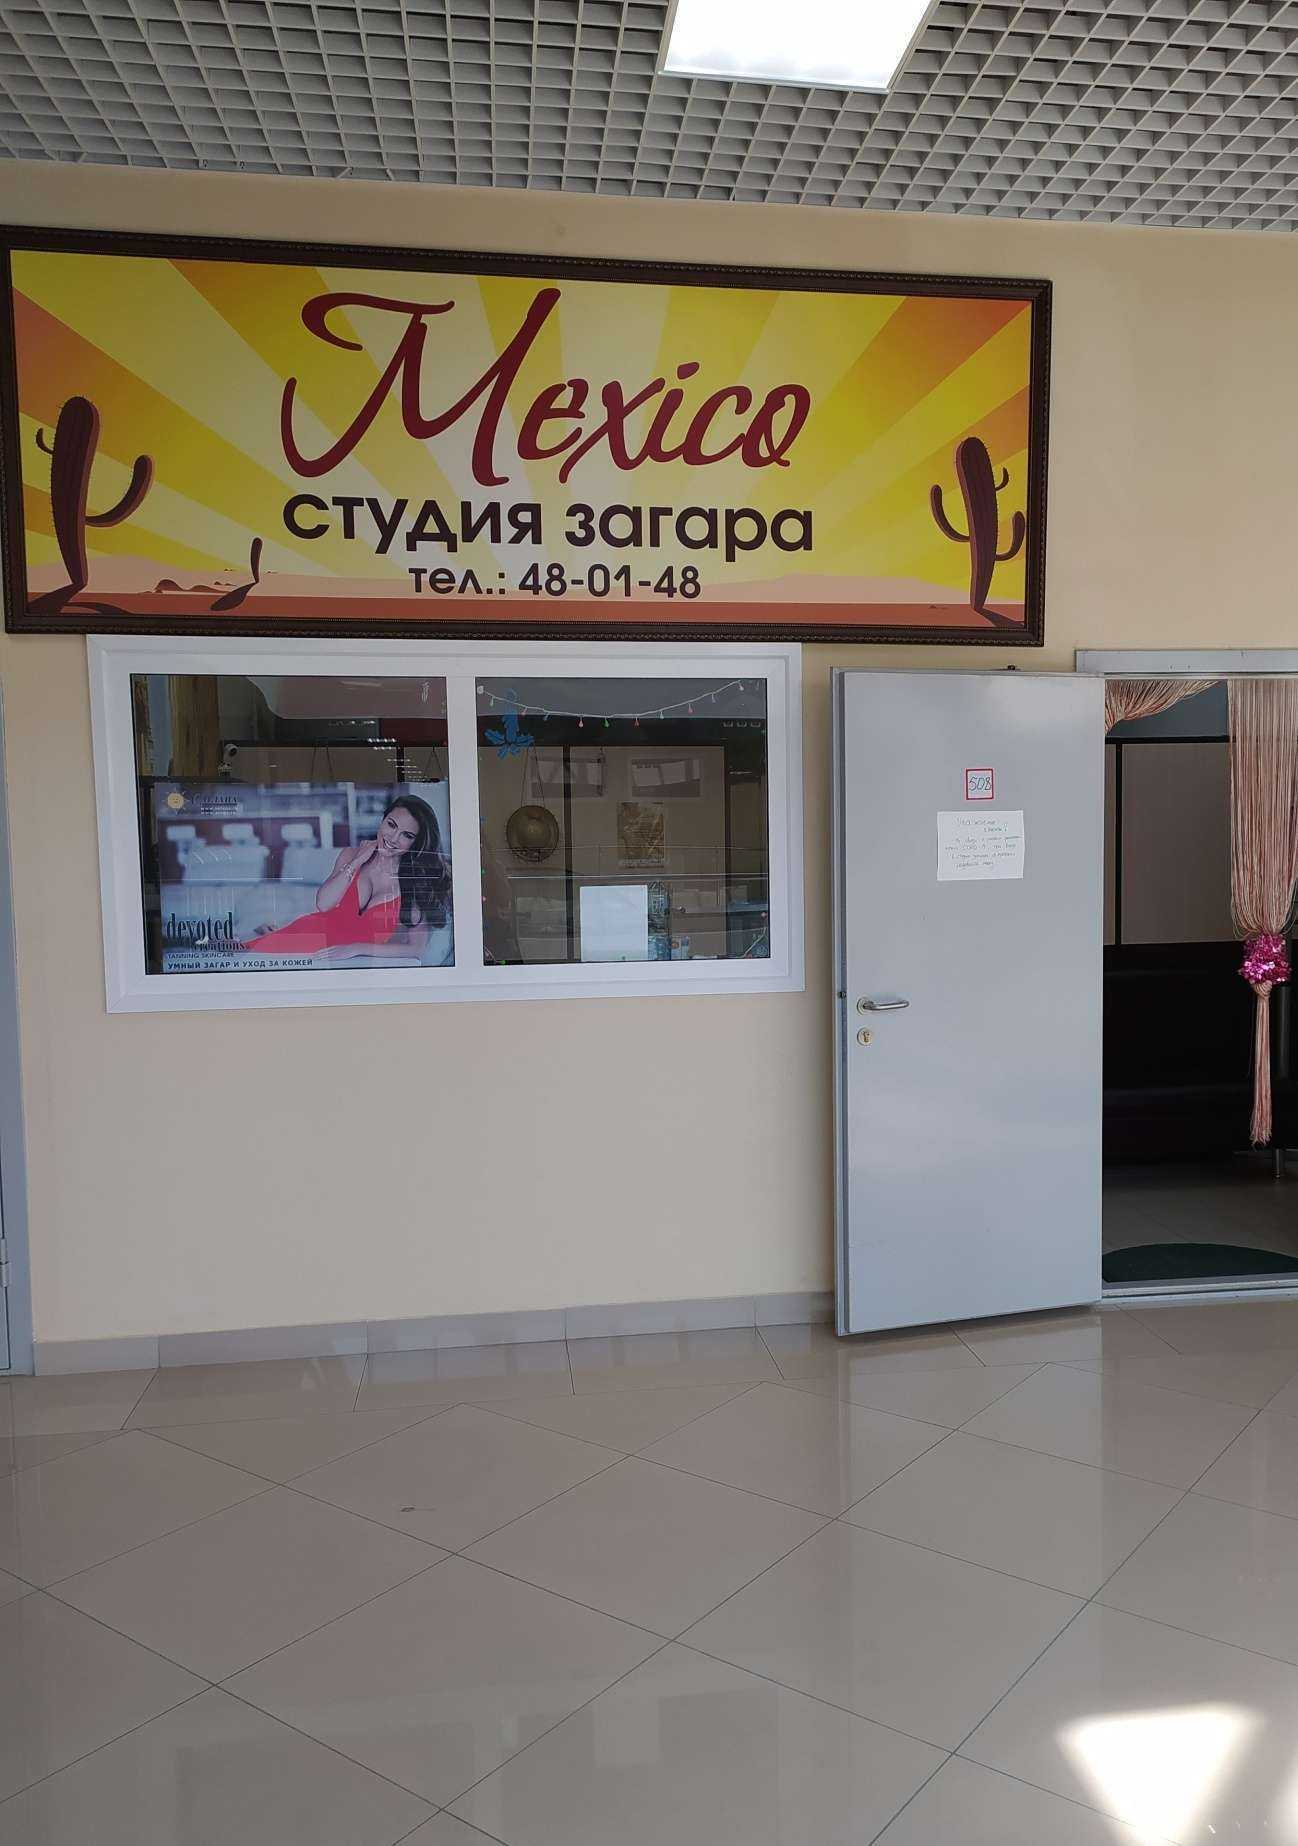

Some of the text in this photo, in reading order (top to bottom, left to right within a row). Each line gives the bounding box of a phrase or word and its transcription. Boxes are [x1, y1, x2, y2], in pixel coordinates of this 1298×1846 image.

[281, 288, 811, 486] Mexico
[565, 503, 813, 562] загара
[518, 563, 701, 599] 48-01-48
[969, 776, 993, 791] 508
[166, 911, 234, 941] devoted
[168, 961, 201, 970] УМНЫЙ
[203, 961, 231, 969] ЗАГАР
[242, 960, 266, 969] УХОД
[282, 958, 313, 967] КОЖЕЙ
